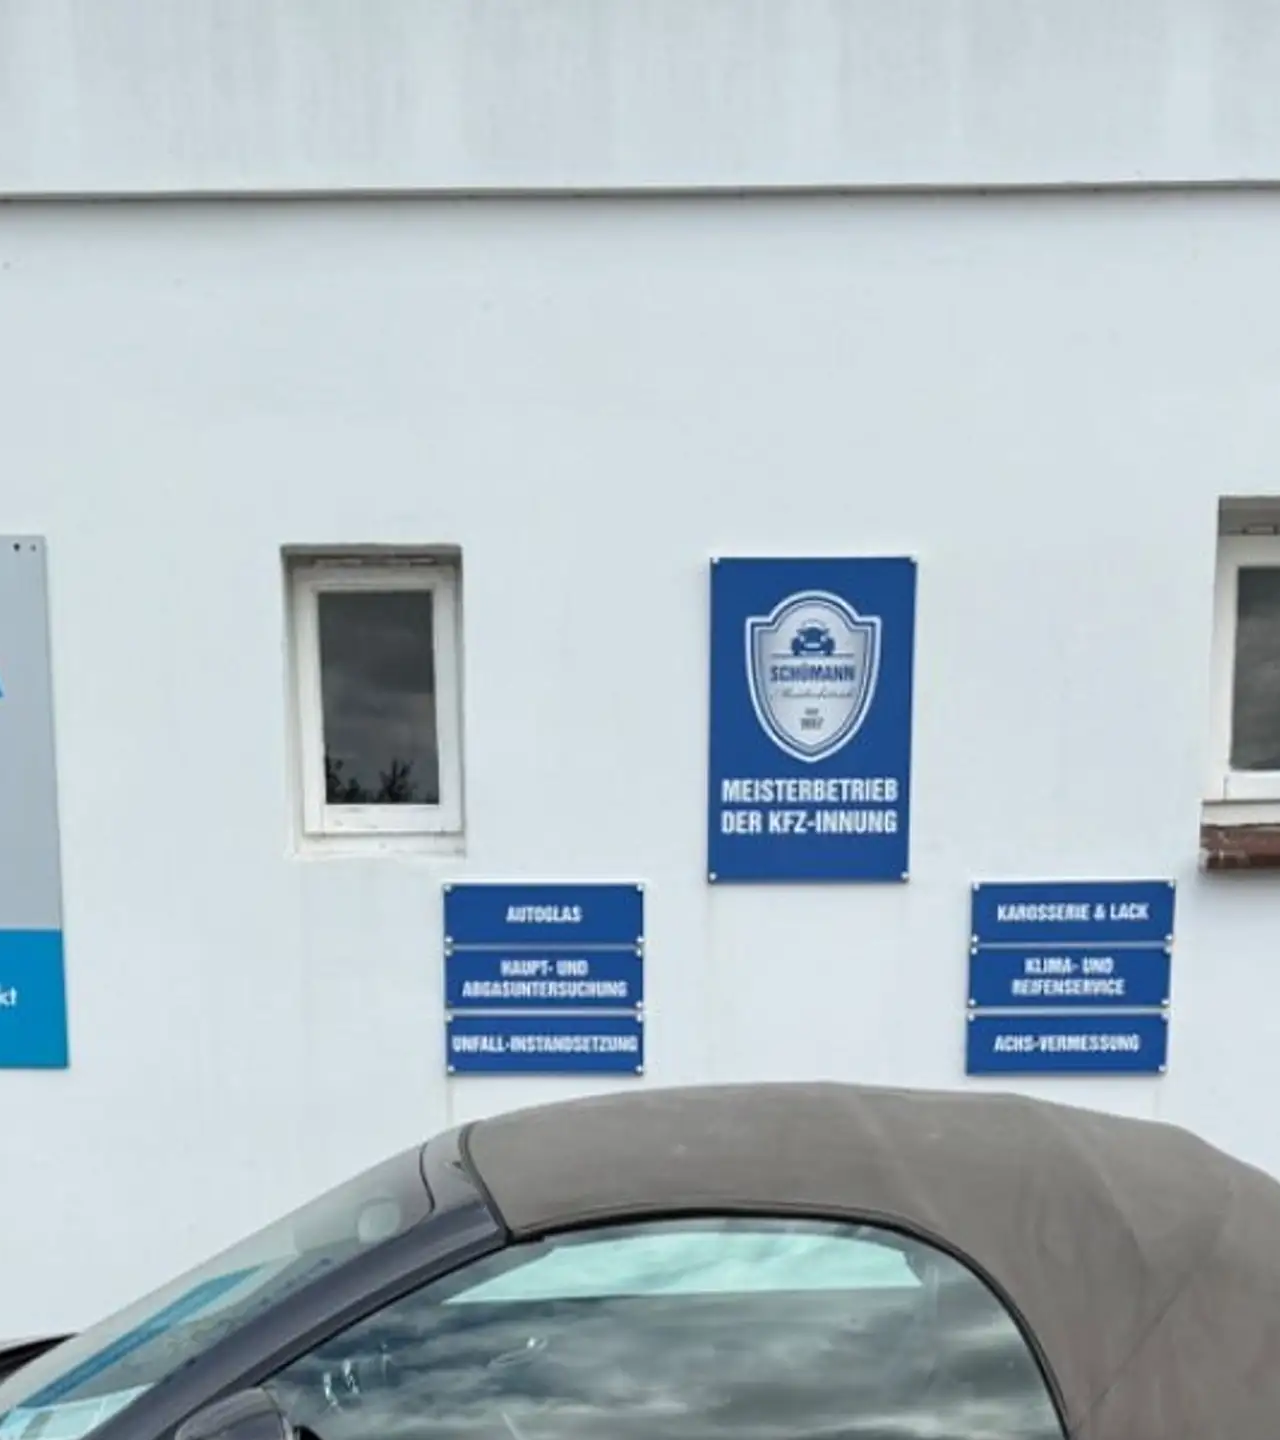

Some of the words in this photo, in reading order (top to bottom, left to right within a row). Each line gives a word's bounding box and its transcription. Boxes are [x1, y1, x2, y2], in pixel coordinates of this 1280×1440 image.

[721, 778, 899, 803] MEISTERBETRIEB
[721, 810, 761, 834] DER
[768, 809, 898, 834] KFZ-INNUNG
[505, 904, 583, 923] AUTOGLAS
[997, 903, 1090, 922] KAROSSERIE
[1093, 903, 1106, 920] &
[1110, 902, 1150, 920] LACK
[500, 959, 554, 976] HAUPT-
[556, 959, 589, 976] UND
[1024, 957, 1080, 975] KLIMA-
[1082, 957, 1114, 974] UND
[462, 980, 629, 998] ABGASUNTERSUCHUNG
[1011, 978, 1126, 996] REIFENSERVICE
[452, 1034, 639, 1052] UNFALL-INSTANDSETZUNG
[993, 1033, 1141, 1053] ACHS-VERMESSUNG
